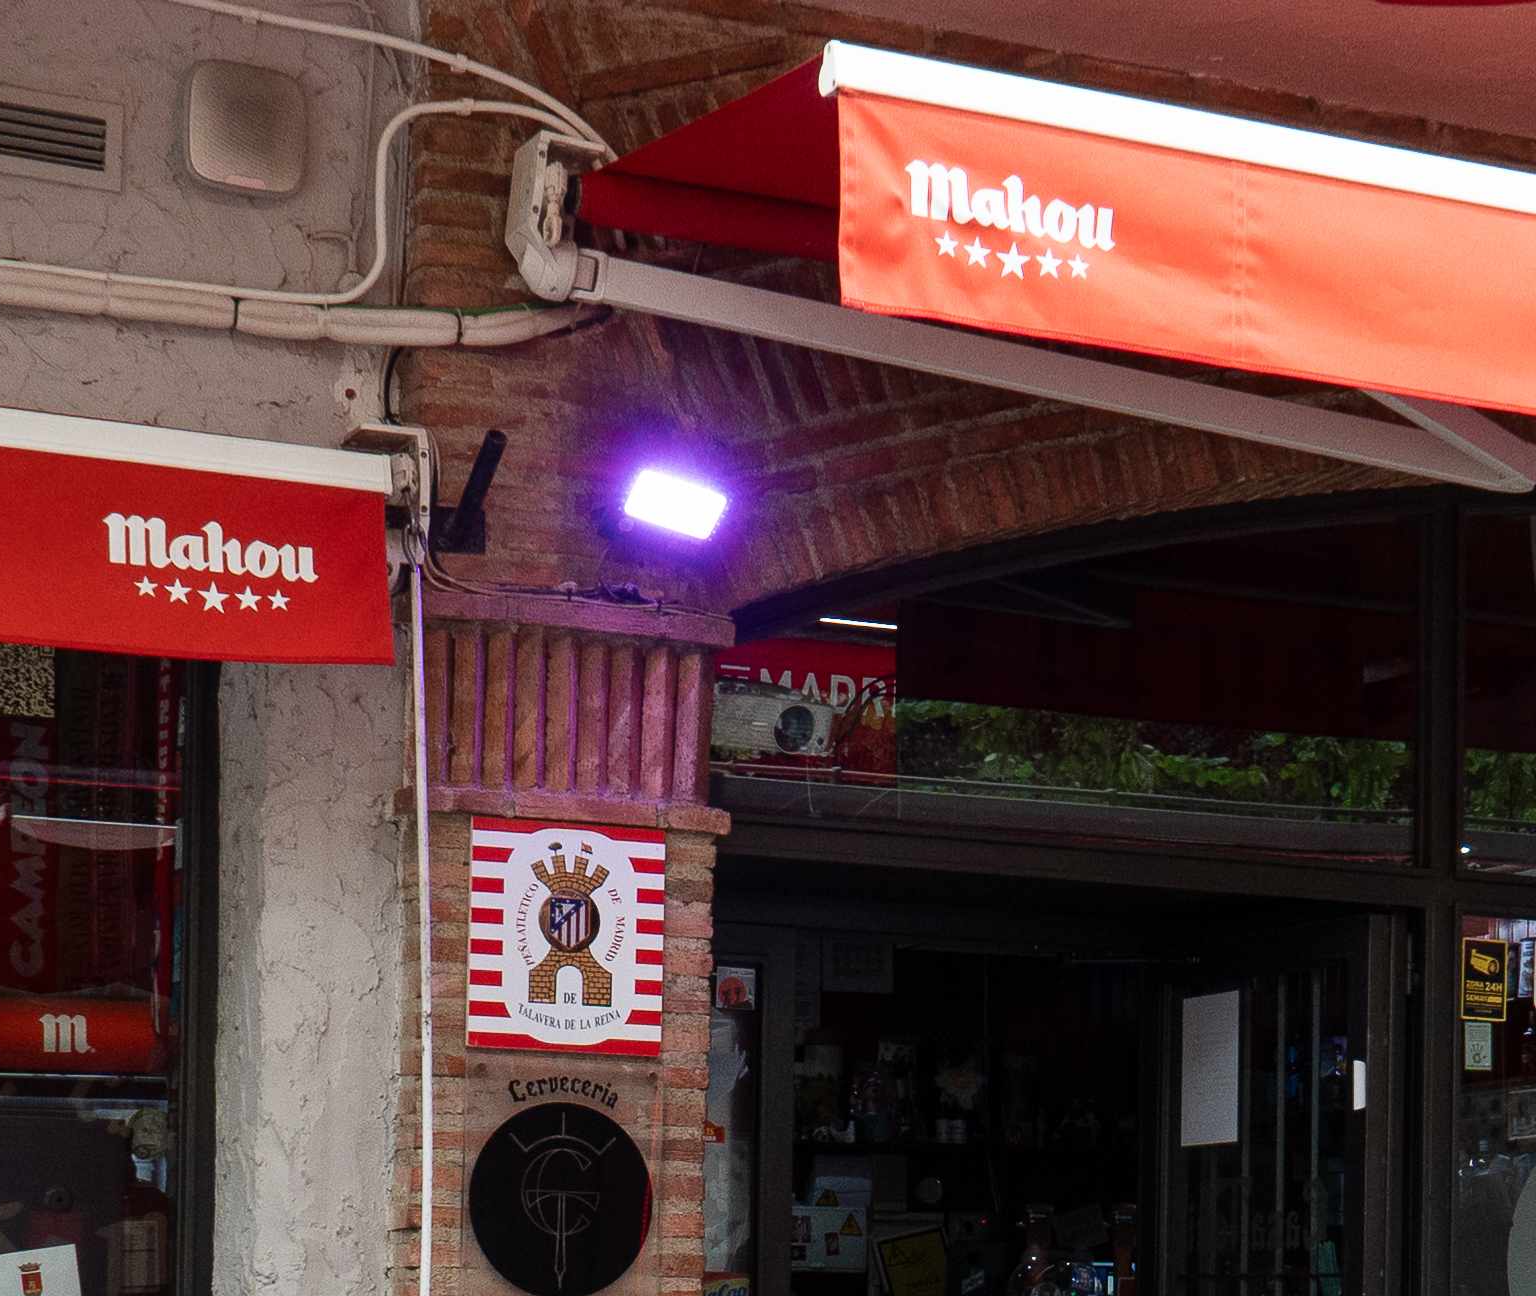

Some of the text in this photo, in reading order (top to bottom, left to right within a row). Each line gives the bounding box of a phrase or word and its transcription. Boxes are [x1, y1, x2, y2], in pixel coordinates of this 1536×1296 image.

[904, 158, 1116, 252] Mahou
[103, 509, 319, 585] Mahou
[607, 888, 623, 905] DE
[605, 915, 627, 963] MADRID
[563, 992, 577, 1005] DE
[518, 1002, 623, 1030] TALAVERA DE LA REINA
[508, 1076, 618, 1109] Cerveceria
